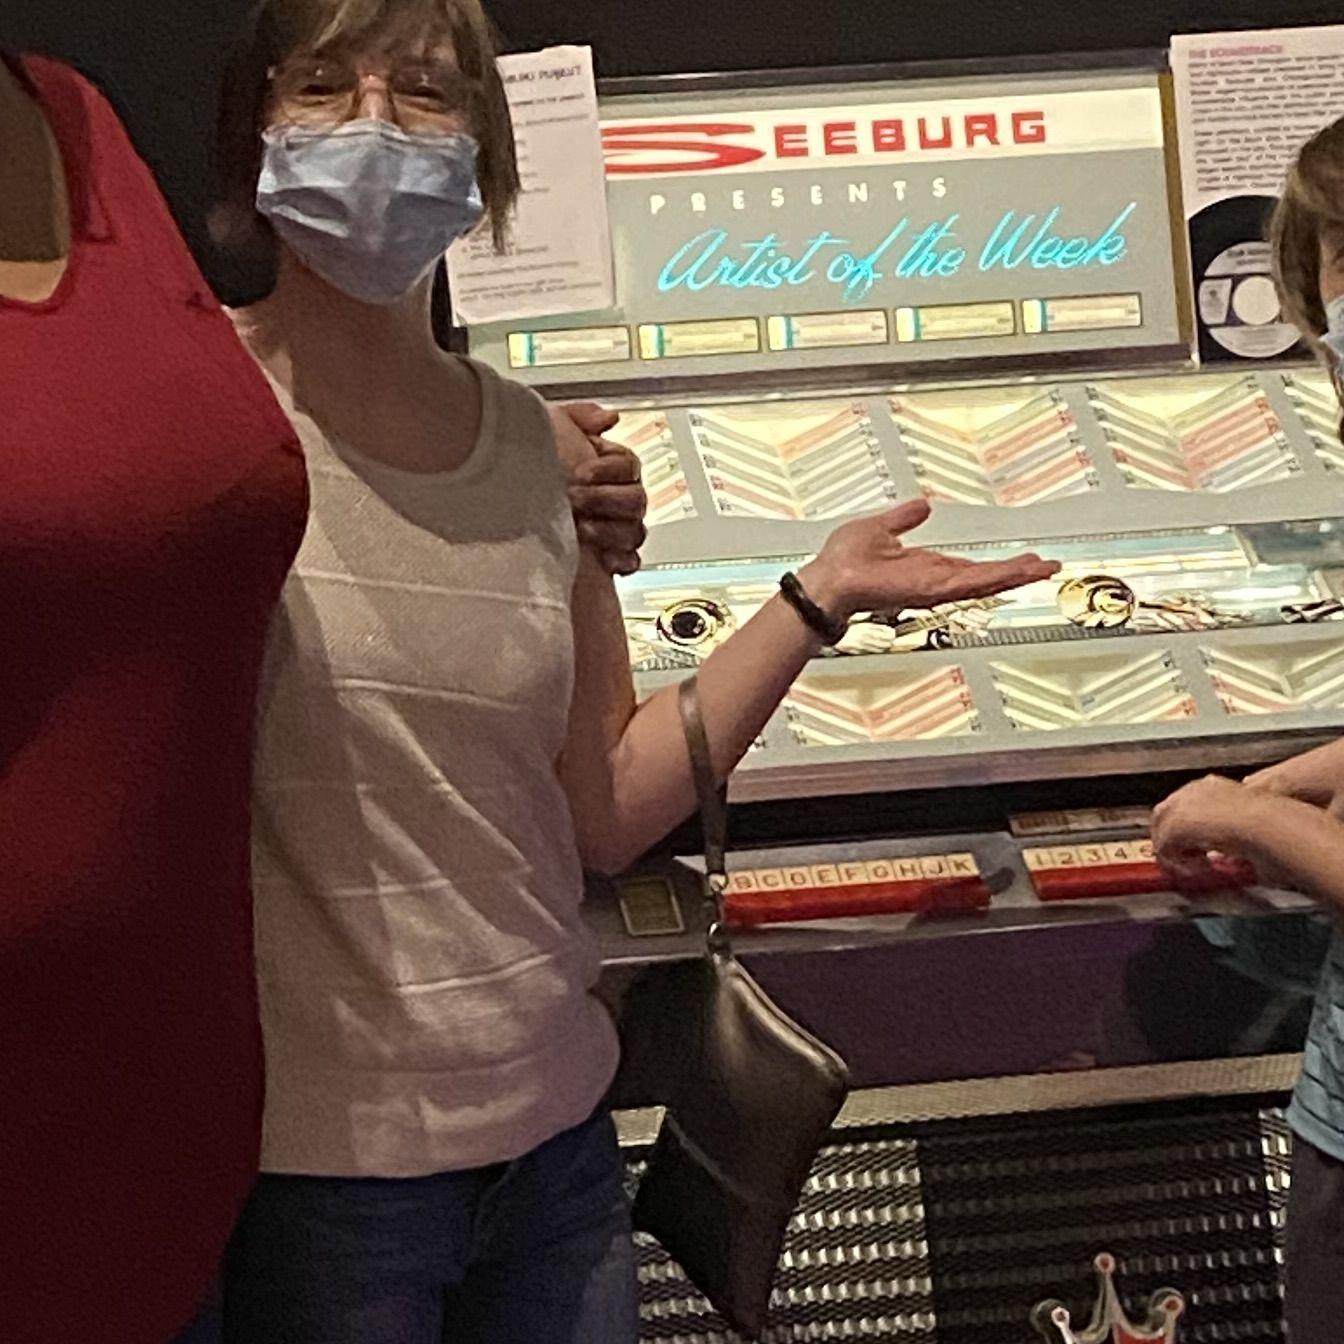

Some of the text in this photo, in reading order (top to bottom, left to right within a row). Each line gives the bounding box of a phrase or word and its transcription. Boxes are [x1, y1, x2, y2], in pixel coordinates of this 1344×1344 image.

[601, 111, 1047, 174] SEEBURG
[649, 176, 947, 214] PRESENTS
[657, 201, 1137, 303] Artist of the Week
